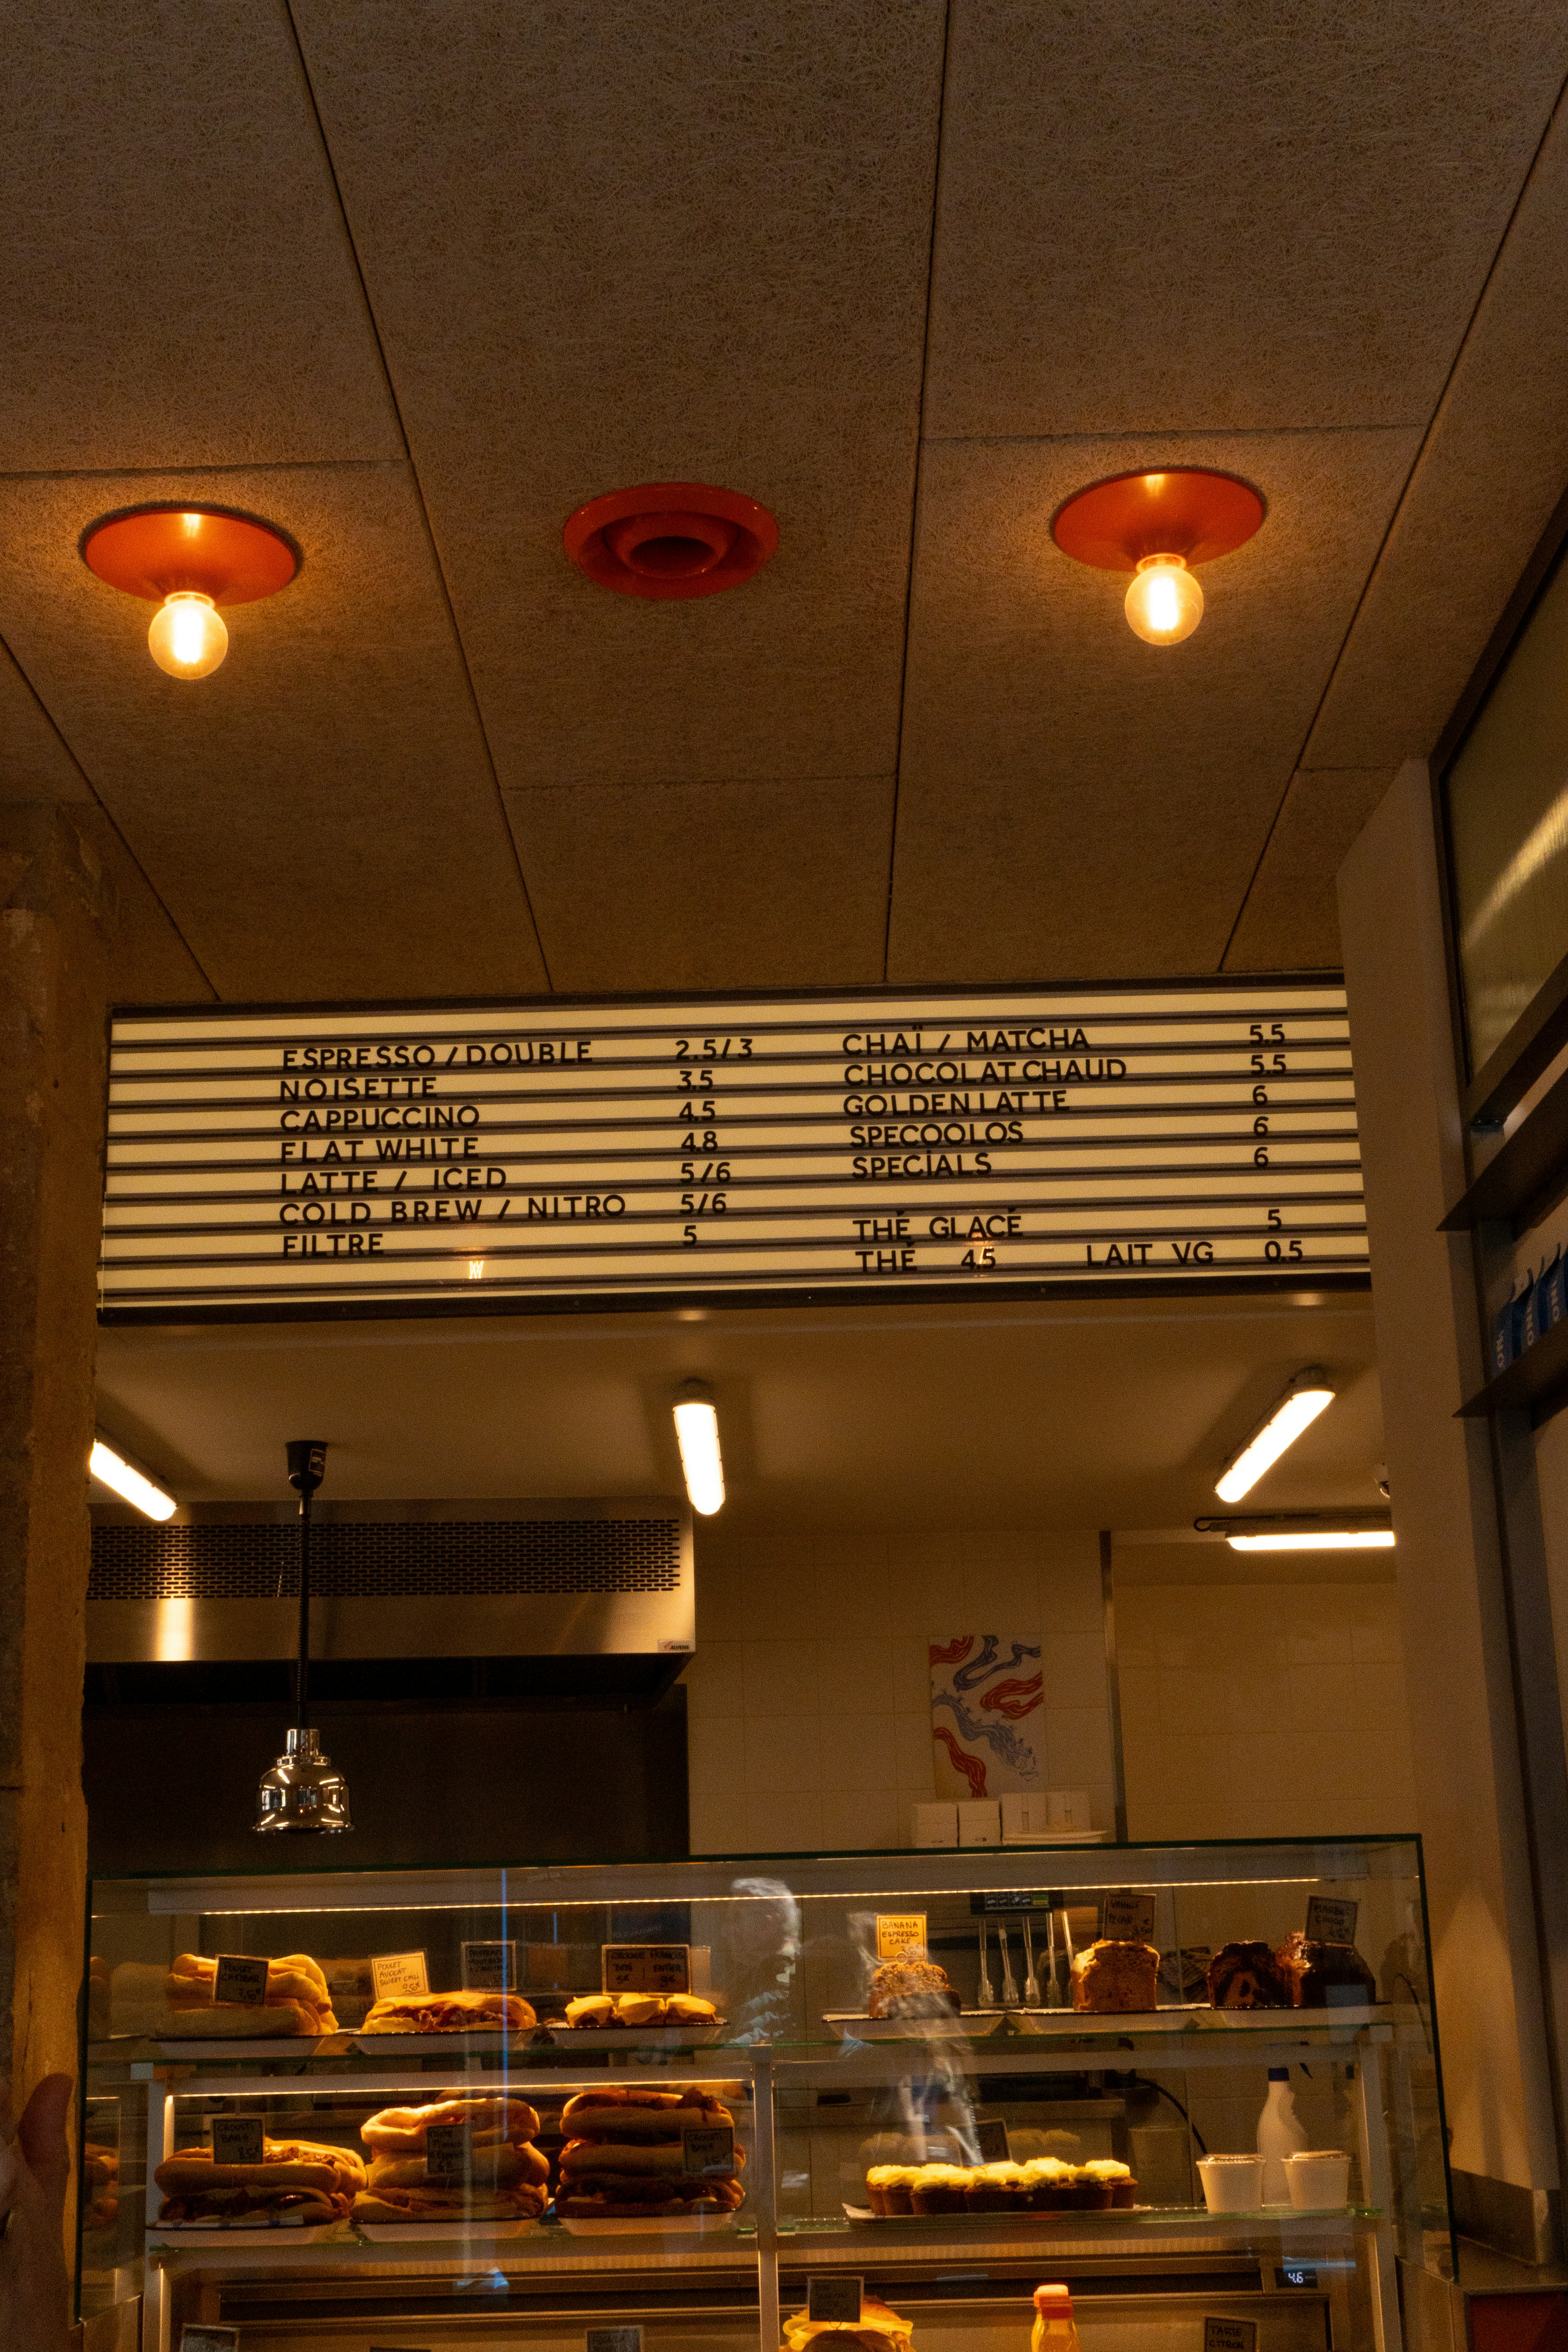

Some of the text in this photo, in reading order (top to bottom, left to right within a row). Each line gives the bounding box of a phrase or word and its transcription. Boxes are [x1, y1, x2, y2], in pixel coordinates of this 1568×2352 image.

[967, 1028, 1090, 1053] MATCHA
[1250, 1024, 1285, 1044] 5.5
[845, 1059, 1126, 1086] CHOCOLAT CHAUD
[1250, 1054, 1286, 1074] 5.5
[280, 1077, 437, 1102] NOISETTE
[677, 1070, 713, 1090] 3.5
[843, 1089, 1070, 1116] GOLDEN LATTE
[1253, 1085, 1268, 1106] 6
[280, 1105, 479, 1132] CAPPUCCINO
[679, 1100, 715, 1122] 4.5
[850, 1121, 1023, 1148] SPECOOLOS
[1253, 1116, 1269, 1137] 6
[280, 1137, 479, 1164] FLAT WHITE
[681, 1131, 718, 1152] 4.8
[1254, 1147, 1269, 1168] 6
[280, 1171, 379, 1196] LATTE
[433, 1167, 506, 1190] ICED
[280, 1202, 371, 1227] COLD
[391, 1199, 482, 1222] BREW
[528, 1194, 626, 1217] NITRO
[1268, 1209, 1282, 1230] 5
[283, 1233, 384, 1258] FILTRE
[683, 1225, 697, 1246] 5
[1087, 1241, 1302, 1266] LAIT VG 0.5
[377, 1961, 401, 1970] POULET
[379, 1967, 407, 1978] AVOCAT
[380, 1977, 401, 1986] SWEET
[1209, 2325, 1242, 2337] TARTE
[1209, 2339, 1244, 2349] CITRON
